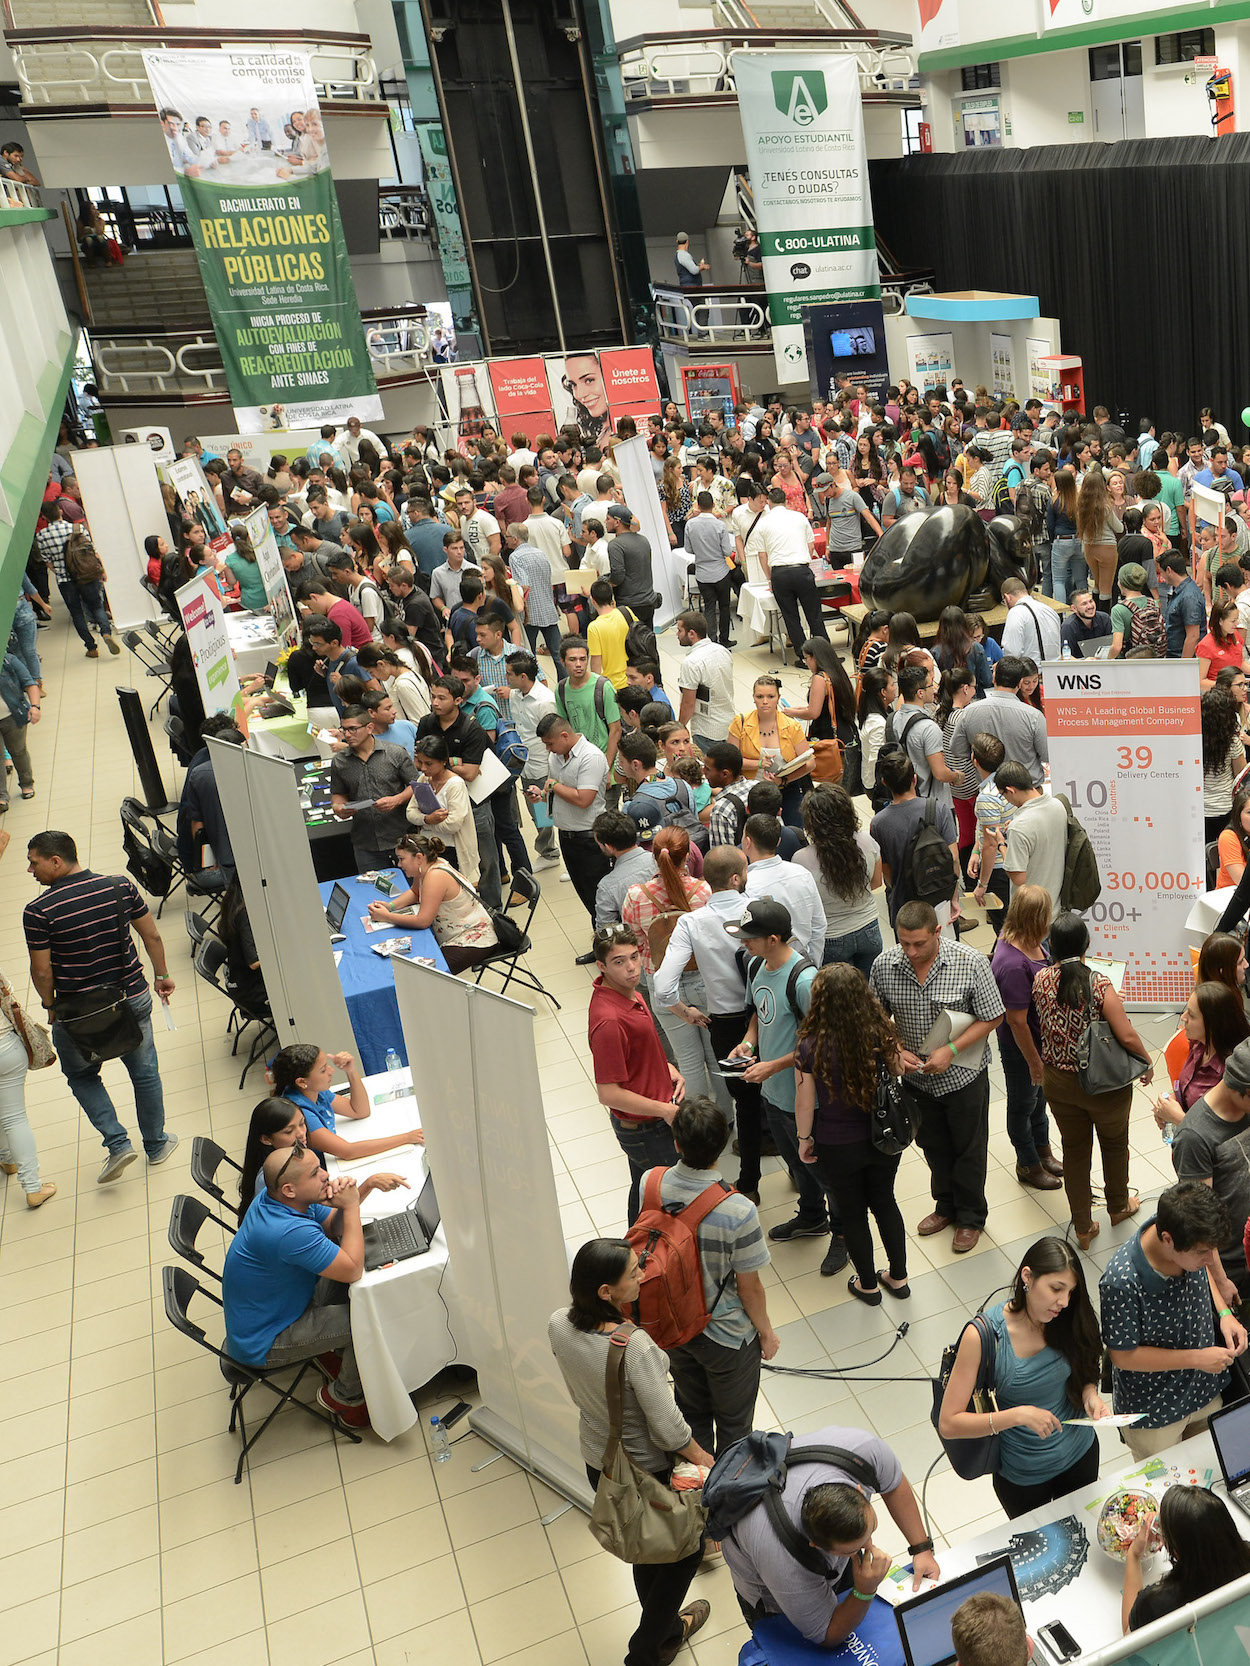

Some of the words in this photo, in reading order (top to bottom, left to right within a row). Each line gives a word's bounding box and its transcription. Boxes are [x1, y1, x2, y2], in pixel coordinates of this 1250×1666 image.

[230, 54, 244, 66] La
[250, 54, 293, 66] calidad
[232, 67, 305, 78] compromiso
[758, 135, 792, 144] APOYO
[794, 134, 854, 144] ESTUDIANTIL
[758, 146, 794, 154] Universidad
[762, 168, 798, 189] ¿TENÉS
[800, 168, 859, 181] CONSULTAS
[788, 184, 796, 194] O
[798, 181, 840, 194] DUDAS?
[219, 198, 286, 213] BACHILLERATO
[288, 196, 301, 210] EN
[200, 214, 330, 249] RELACIONES
[785, 234, 860, 250] 800-ULATINA
[224, 249, 325, 284] PÚBLICAS
[792, 266, 809, 276] chat
[228, 286, 265, 297] Universidad
[266, 285, 286, 296] Latina
[286, 284, 295, 294] de
[296, 283, 314, 293] Costa
[261, 296, 278, 306] Sede
[280, 294, 303, 304] Heredia
[250, 314, 275, 328] INICIA
[275, 312, 310, 326] PROCESO
[312, 312, 322, 324] DE
[236, 319, 342, 346] AUTOEVALUACIÓN
[268, 344, 286, 355] CON
[286, 342, 306, 354] FINES
[308, 341, 318, 352] DE
[240, 346, 354, 376] REACREDITACIÓN
[270, 374, 295, 388] ANTE
[297, 370, 330, 386] SINAES
[612, 368, 639, 378] Únete
[498, 384, 512, 392] lado
[512, 382, 544, 390] Coca-Cola
[502, 378, 526, 386] Trabaja
[611, 376, 650, 386] nosotros
[287, 406, 329, 414] UNIVERSIDAD
[230, 440, 254, 450] ÚNICO
[469, 520, 480, 544] AERO
[184, 601, 206, 624] Welcome!
[1056, 674, 1102, 690] WNS
[1056, 707, 1078, 716] WNS
[1094, 706, 1128, 716] Leading
[1128, 706, 1156, 714] Global
[1158, 706, 1196, 714] Business
[1057, 718, 1089, 726] Process
[1091, 718, 1144, 728] Management
[1146, 716, 1184, 726] Company
[1116, 746, 1153, 770] 39
[1117, 771, 1148, 780] Delivery
[1150, 771, 1180, 779] Centers
[1066, 780, 1108, 808] 10
[1110, 780, 1118, 815] Countries
[1106, 872, 1204, 894] 30,000+
[1157, 892, 1198, 900] Employees
